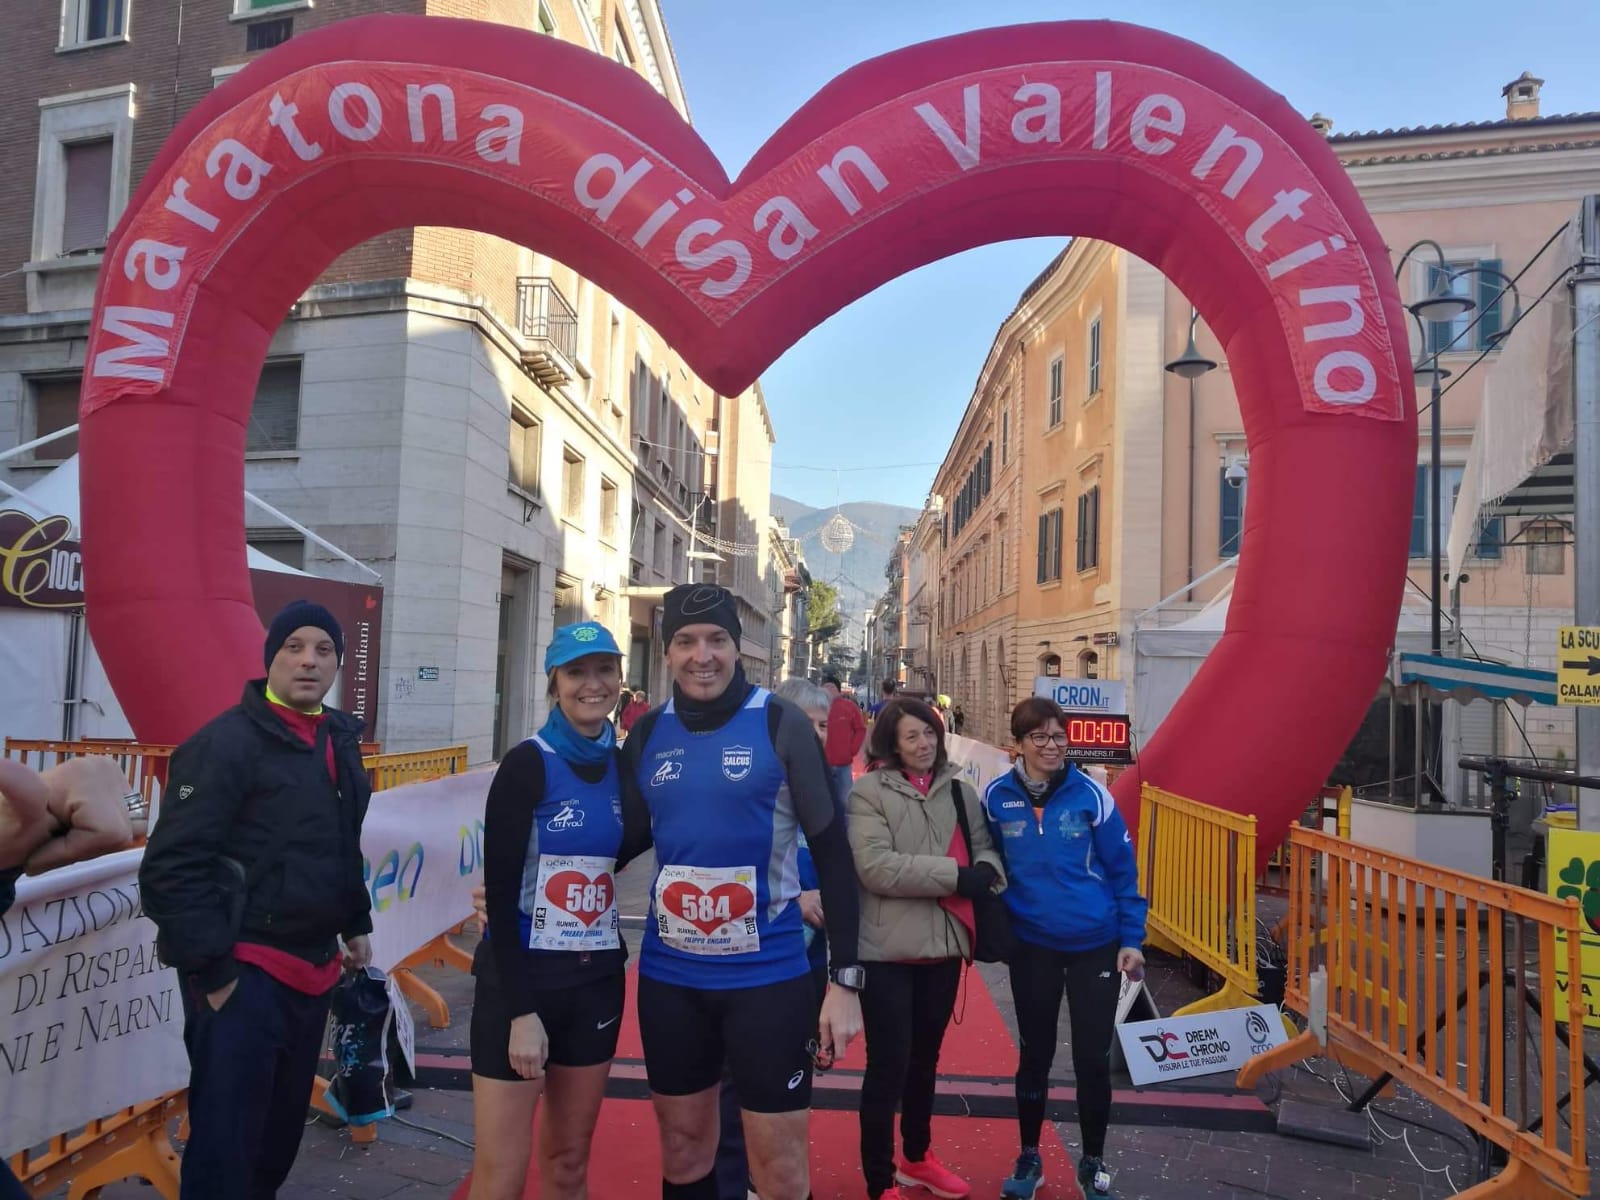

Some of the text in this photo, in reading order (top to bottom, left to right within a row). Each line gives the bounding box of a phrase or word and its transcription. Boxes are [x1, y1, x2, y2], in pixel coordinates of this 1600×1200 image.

[93, 71, 1377, 405] Maratona di San Valentino
[0, 510, 84, 607] CIOC
[354, 621, 369, 681] italiani
[1561, 631, 1575, 649] LA
[1070, 720, 1126, 744] 00:00
[723, 756, 749, 767] SALCUS
[1065, 749, 1115, 758] AMRUNNERS.IT
[566, 820, 583, 828] YOU
[566, 883, 607, 913] 585
[682, 894, 731, 922] 584
[0, 883, 144, 959] AZION
[12, 968, 49, 1015] DI
[1556, 979, 1593, 997] VA
[40, 1022, 64, 1064] E
[75, 989, 173, 1051] NARNI
[1185, 1028, 1220, 1044] DREAM
[1190, 1041, 1231, 1057] CHRONO
[1158, 1061, 1182, 1073] MISURA
[1182, 1060, 1189, 1069] LE
[1188, 1058, 1202, 1068] TUE
